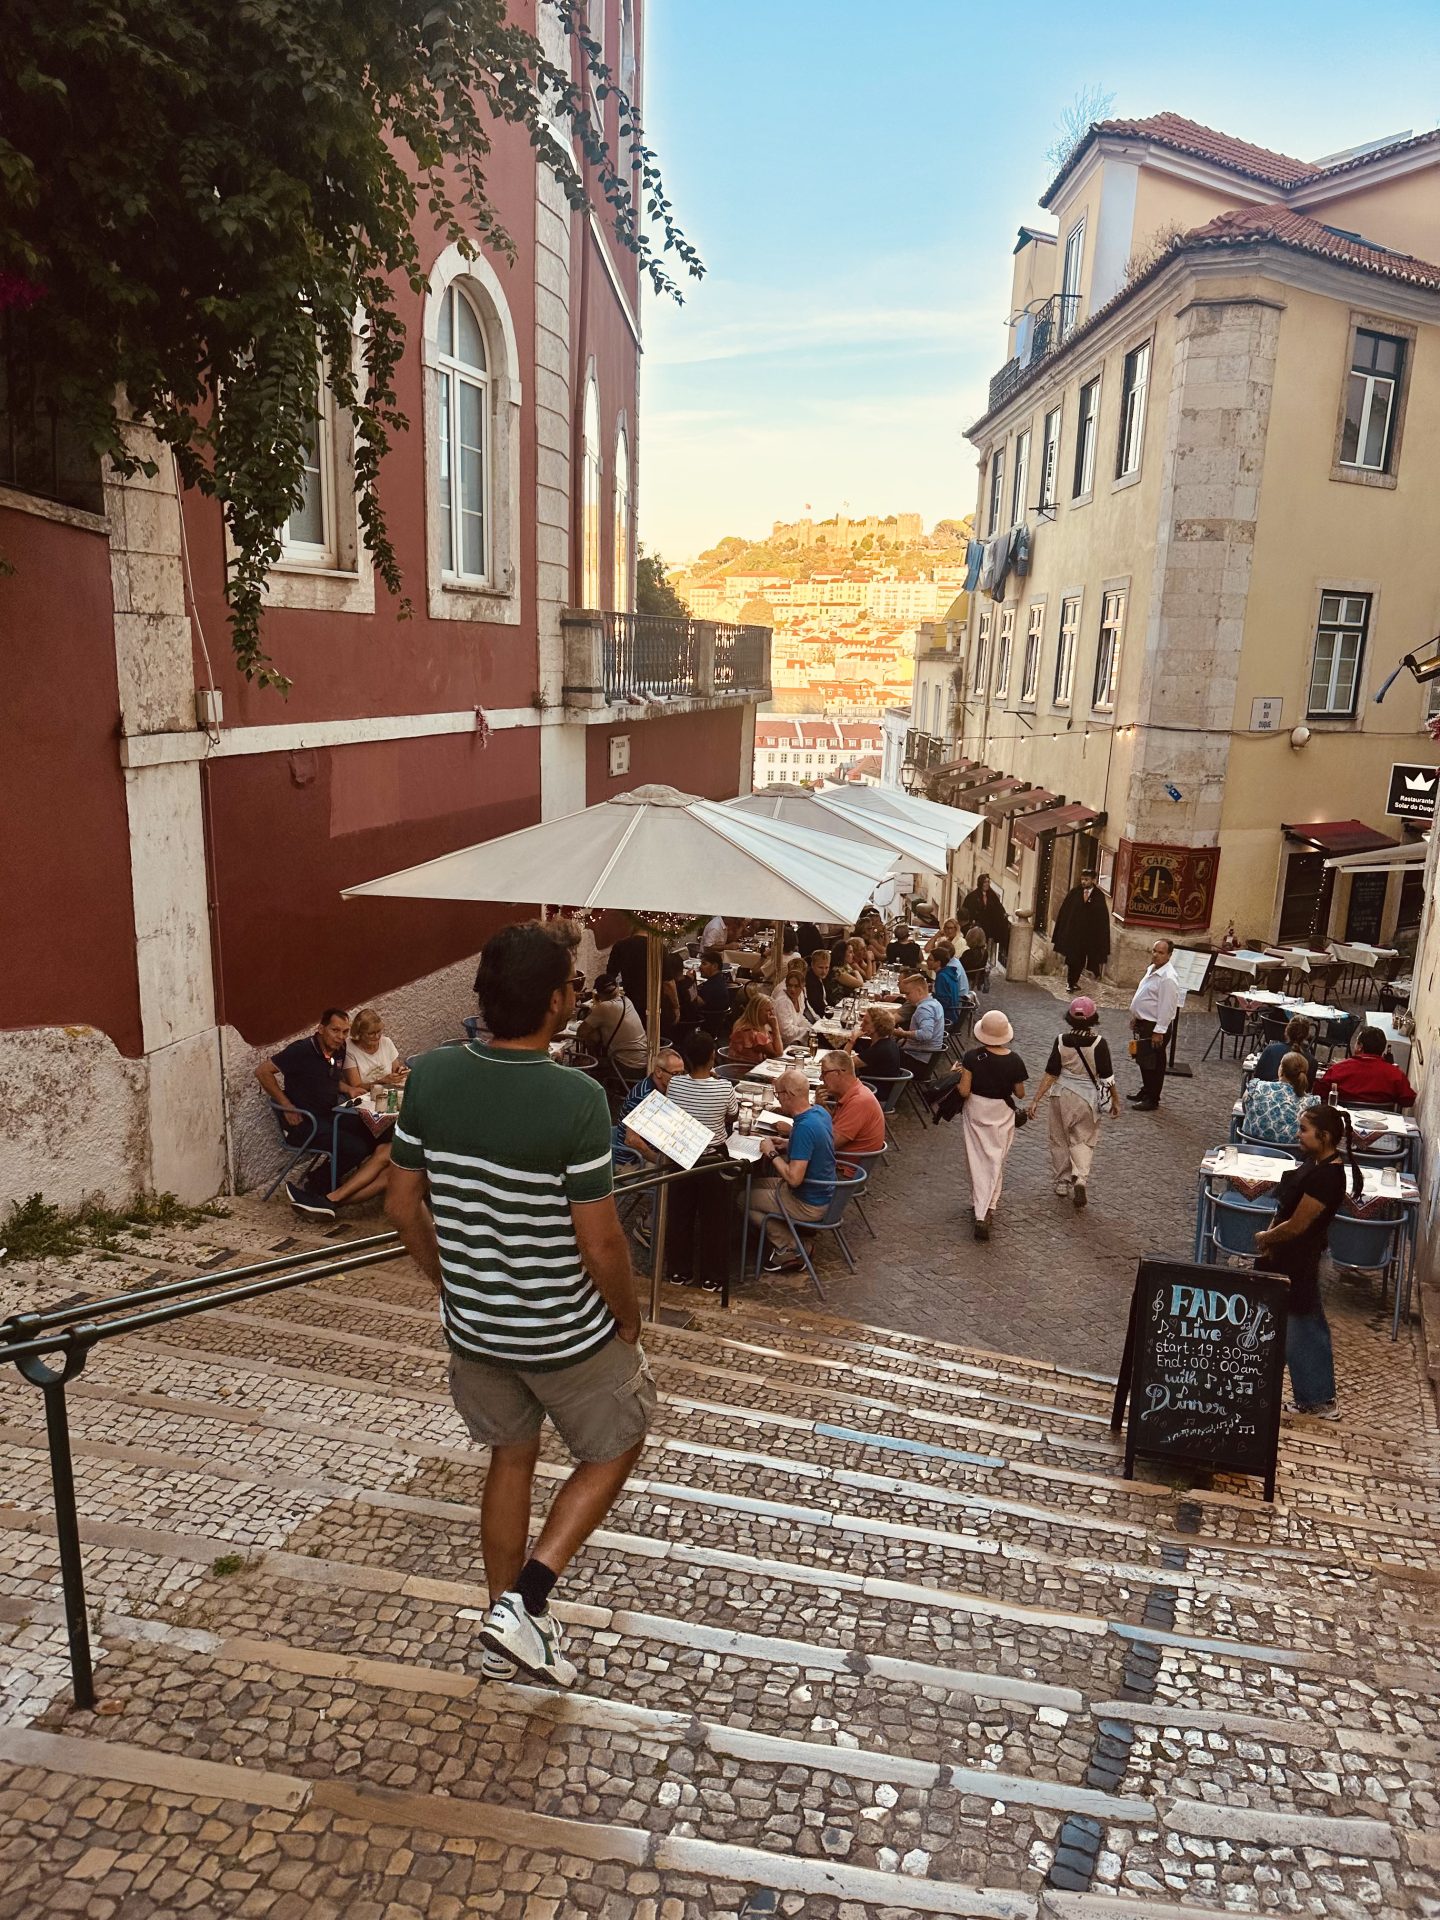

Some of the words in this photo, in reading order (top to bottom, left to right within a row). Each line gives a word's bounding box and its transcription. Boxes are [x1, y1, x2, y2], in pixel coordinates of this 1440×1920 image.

[1400, 795, 1434, 805] Restaurante
[1418, 805, 1435, 813] Duqu
[1169, 1284, 1249, 1326] FADO
[1179, 1319, 1223, 1342] Live
[1164, 1368, 1199, 1386] with
[1140, 1383, 1228, 1421] Dinner
